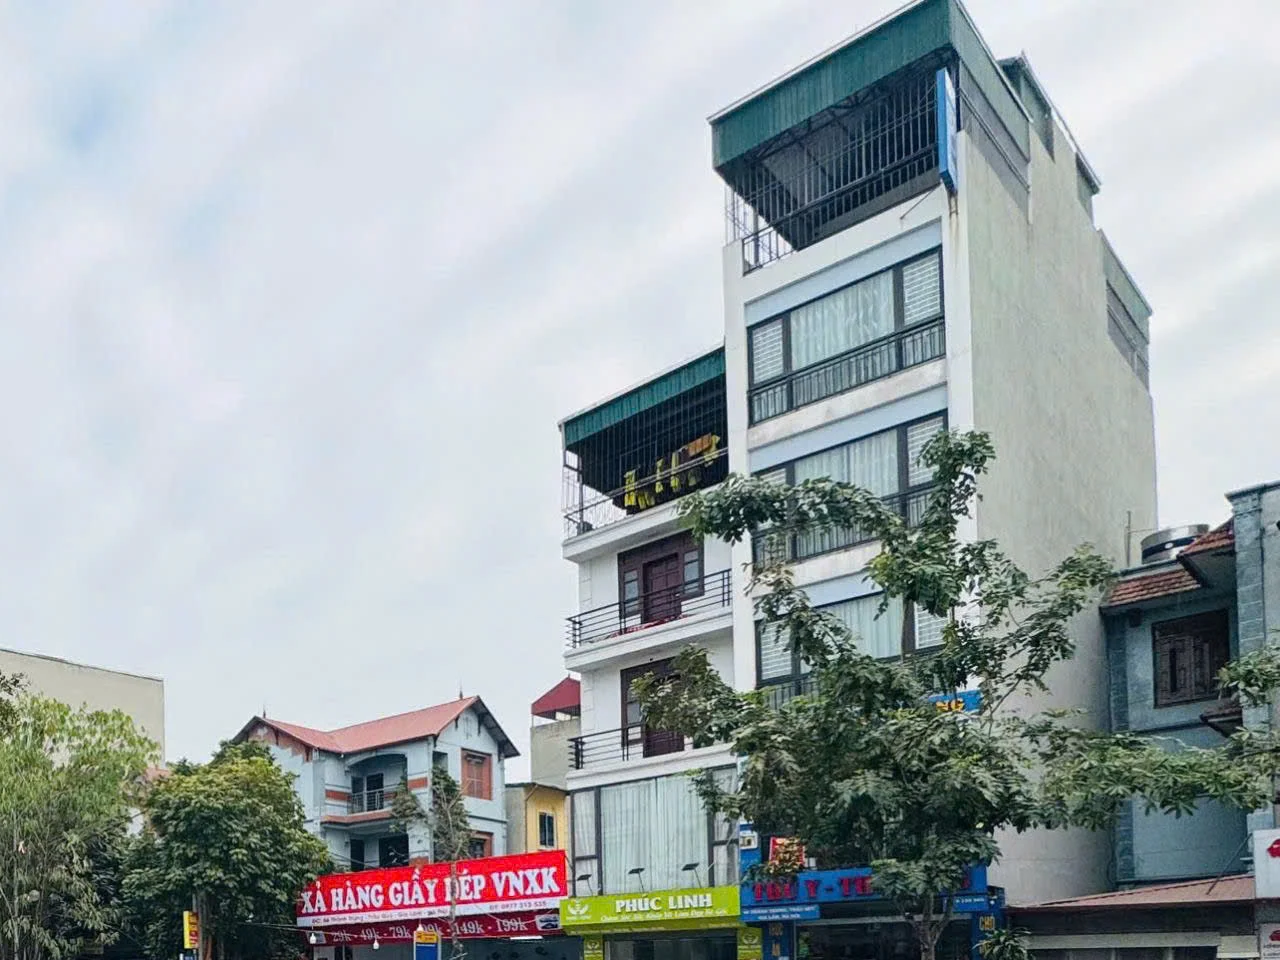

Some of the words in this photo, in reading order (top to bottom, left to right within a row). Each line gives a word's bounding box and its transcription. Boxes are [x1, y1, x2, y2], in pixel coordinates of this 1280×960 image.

[301, 880, 327, 914] XẢ
[331, 879, 385, 911] HÀNG
[389, 867, 439, 906] GIẦY
[491, 866, 560, 898] VNXK
[615, 894, 662, 913] PHÚC
[668, 893, 713, 910] LINH
[389, 926, 412, 939] 79k
[455, 920, 485, 935] 149k
[495, 917, 528, 932] 199k
